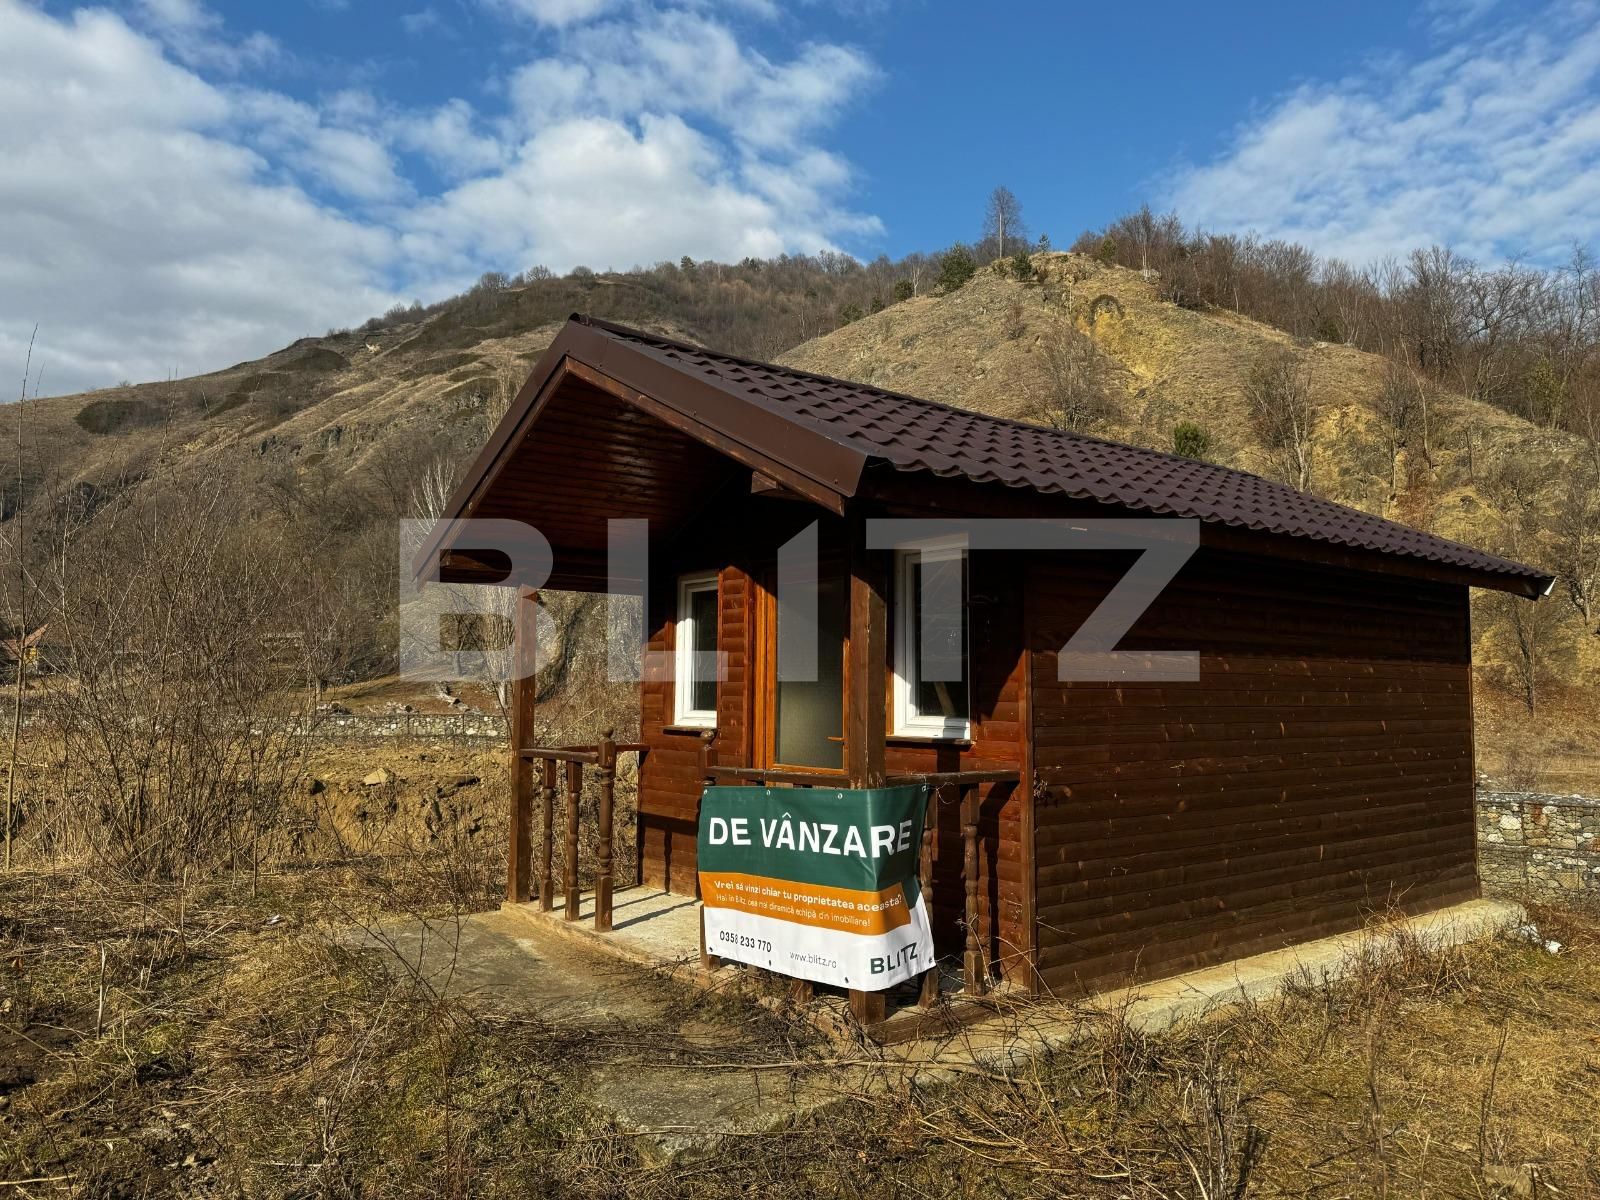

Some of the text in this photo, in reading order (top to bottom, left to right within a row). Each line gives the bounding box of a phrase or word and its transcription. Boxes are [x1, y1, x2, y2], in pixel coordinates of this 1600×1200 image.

[709, 811, 912, 858] DE VÂNZARE
[714, 880, 734, 889] Vrei
[745, 885, 761, 894] vinzi
[761, 887, 781, 897] chiar
[783, 890, 792, 900] tu
[793, 893, 855, 910] proprietatea
[856, 893, 902, 912] aceasta?
[831, 913, 871, 927] imobiliare!
[740, 935, 755, 949] 233
[757, 939, 772, 953] 770
[789, 950, 837, 969] www.blitz.ro
[870, 942, 918, 975] BLITZ
